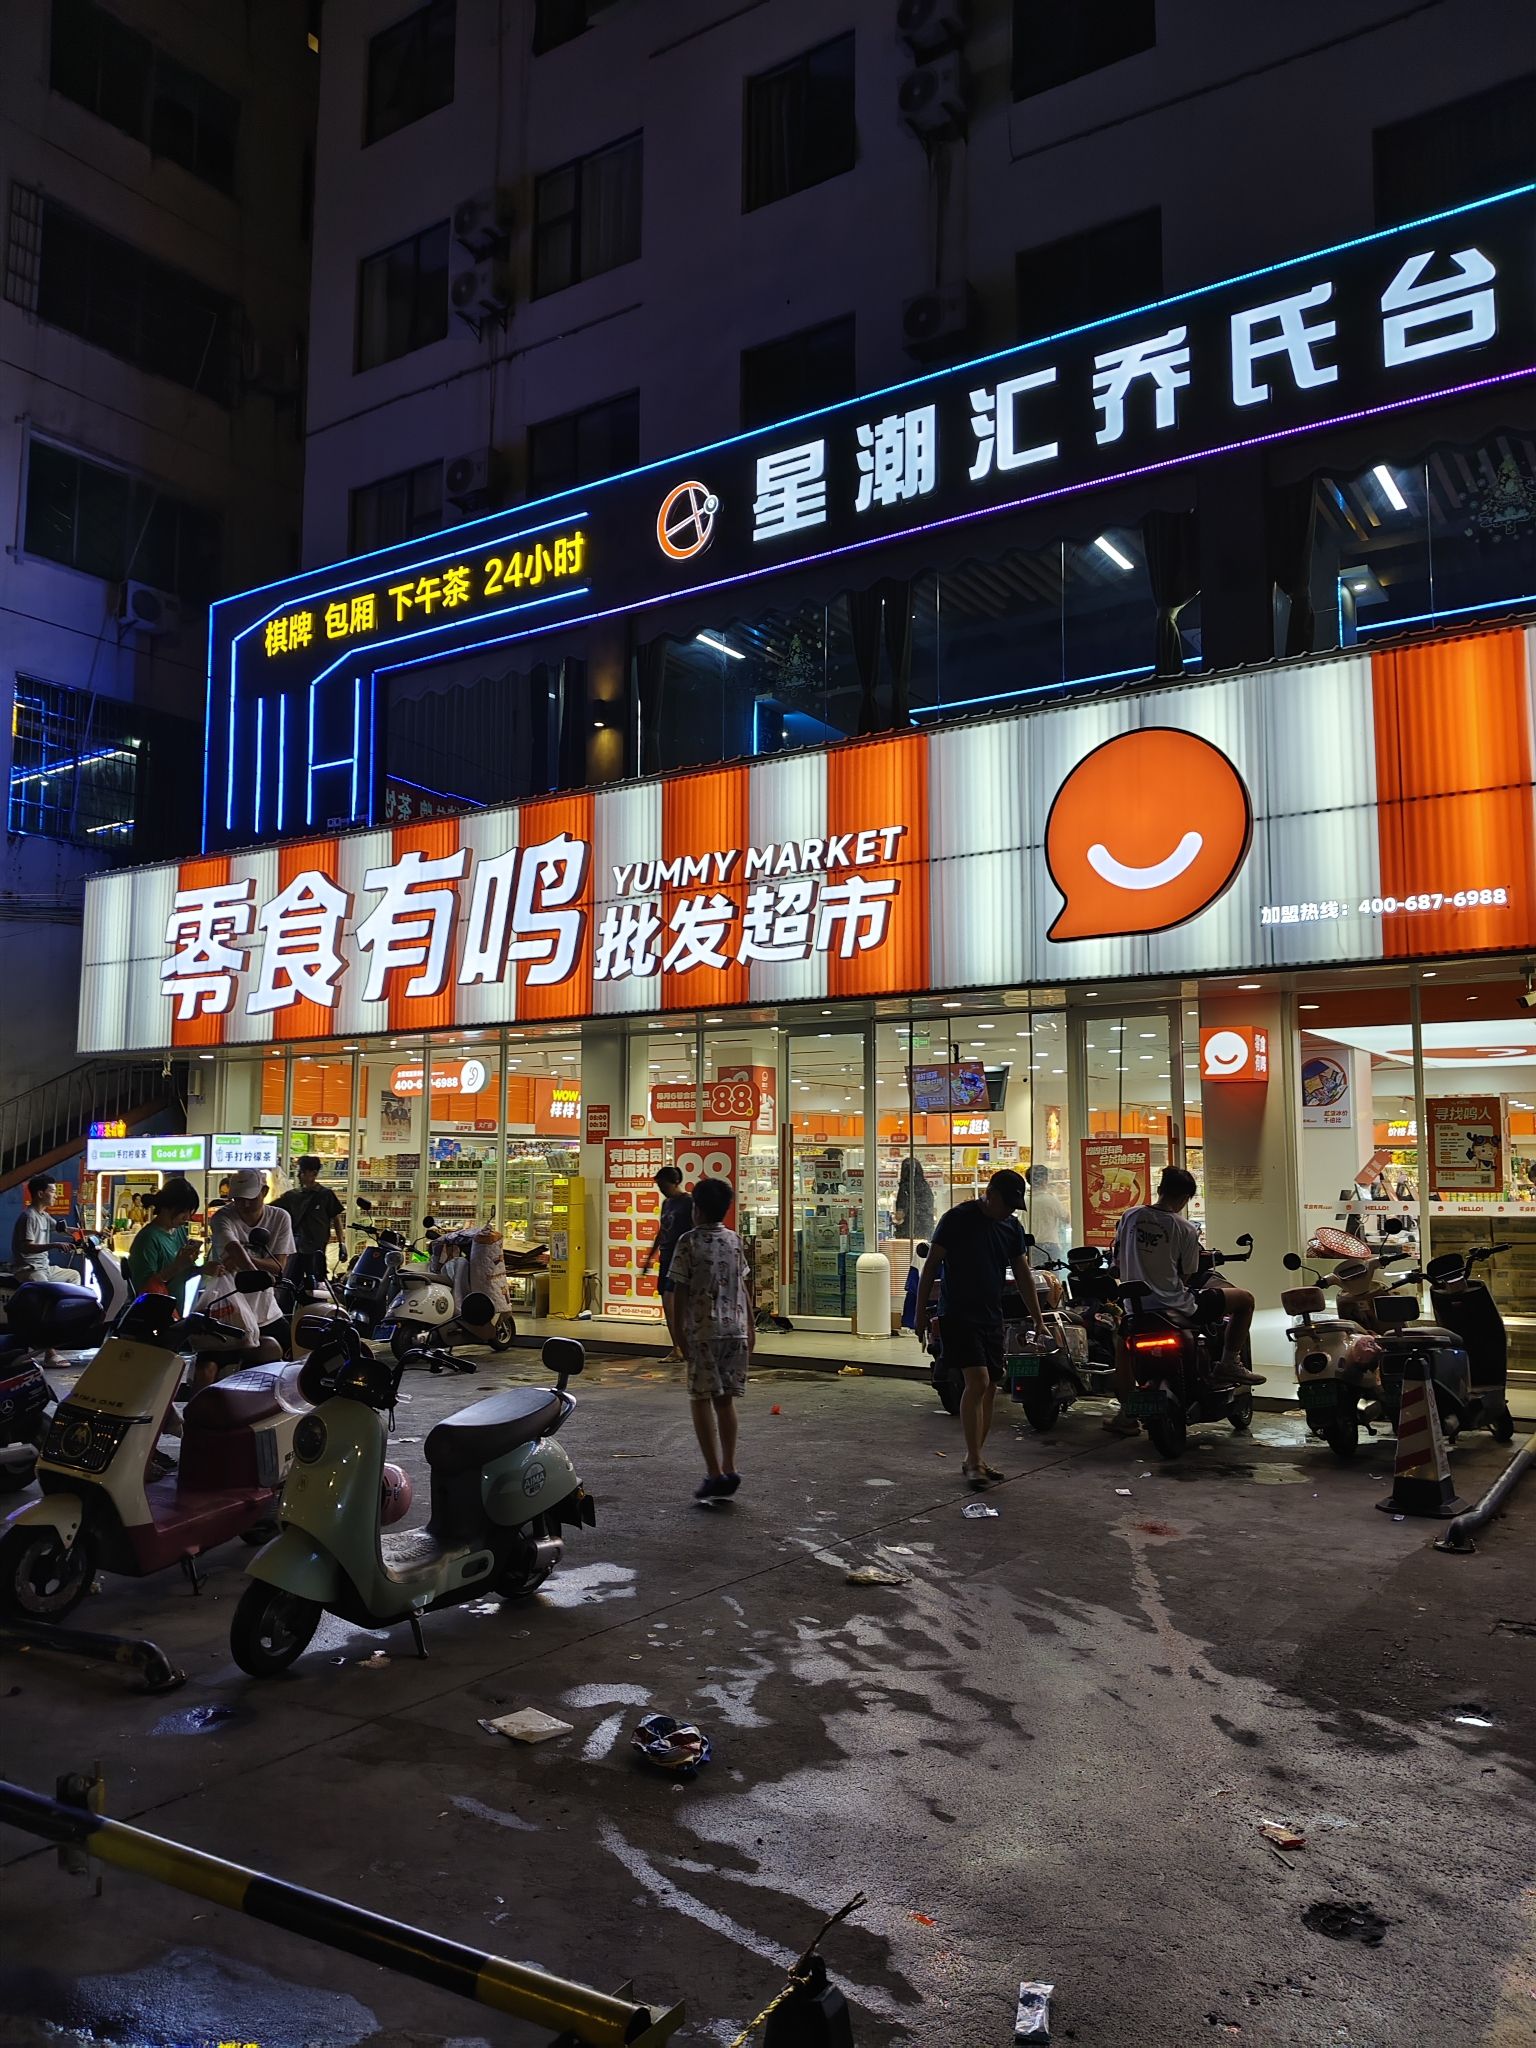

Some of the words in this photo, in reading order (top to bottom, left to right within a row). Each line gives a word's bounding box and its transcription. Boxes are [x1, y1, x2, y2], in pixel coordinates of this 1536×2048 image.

[752, 247, 1497, 543] 星潮汇乔氏台
[264, 609, 313, 658] 棋牌
[325, 592, 376, 639] 包厢
[389, 567, 471, 622] 下午茶
[484, 531, 585, 596] 24小时
[612, 850, 733, 896] YUMMY
[744, 825, 908, 876] MARKET
[160, 831, 588, 1020] 零食有鸣
[595, 875, 901, 981] 批发超市
[394, 1077, 459, 1091] 400-6-6988
[552, 1089, 579, 1102] WOW
[711, 1084, 753, 1116] 88
[1435, 1106, 1492, 1121] 寻找鸣人
[157, 1149, 177, 1159] Good
[225, 1151, 271, 1162] 手打柠檬茶
[609, 1148, 662, 1163] 有鸣会员
[524, 1471, 545, 1489] AIMA
